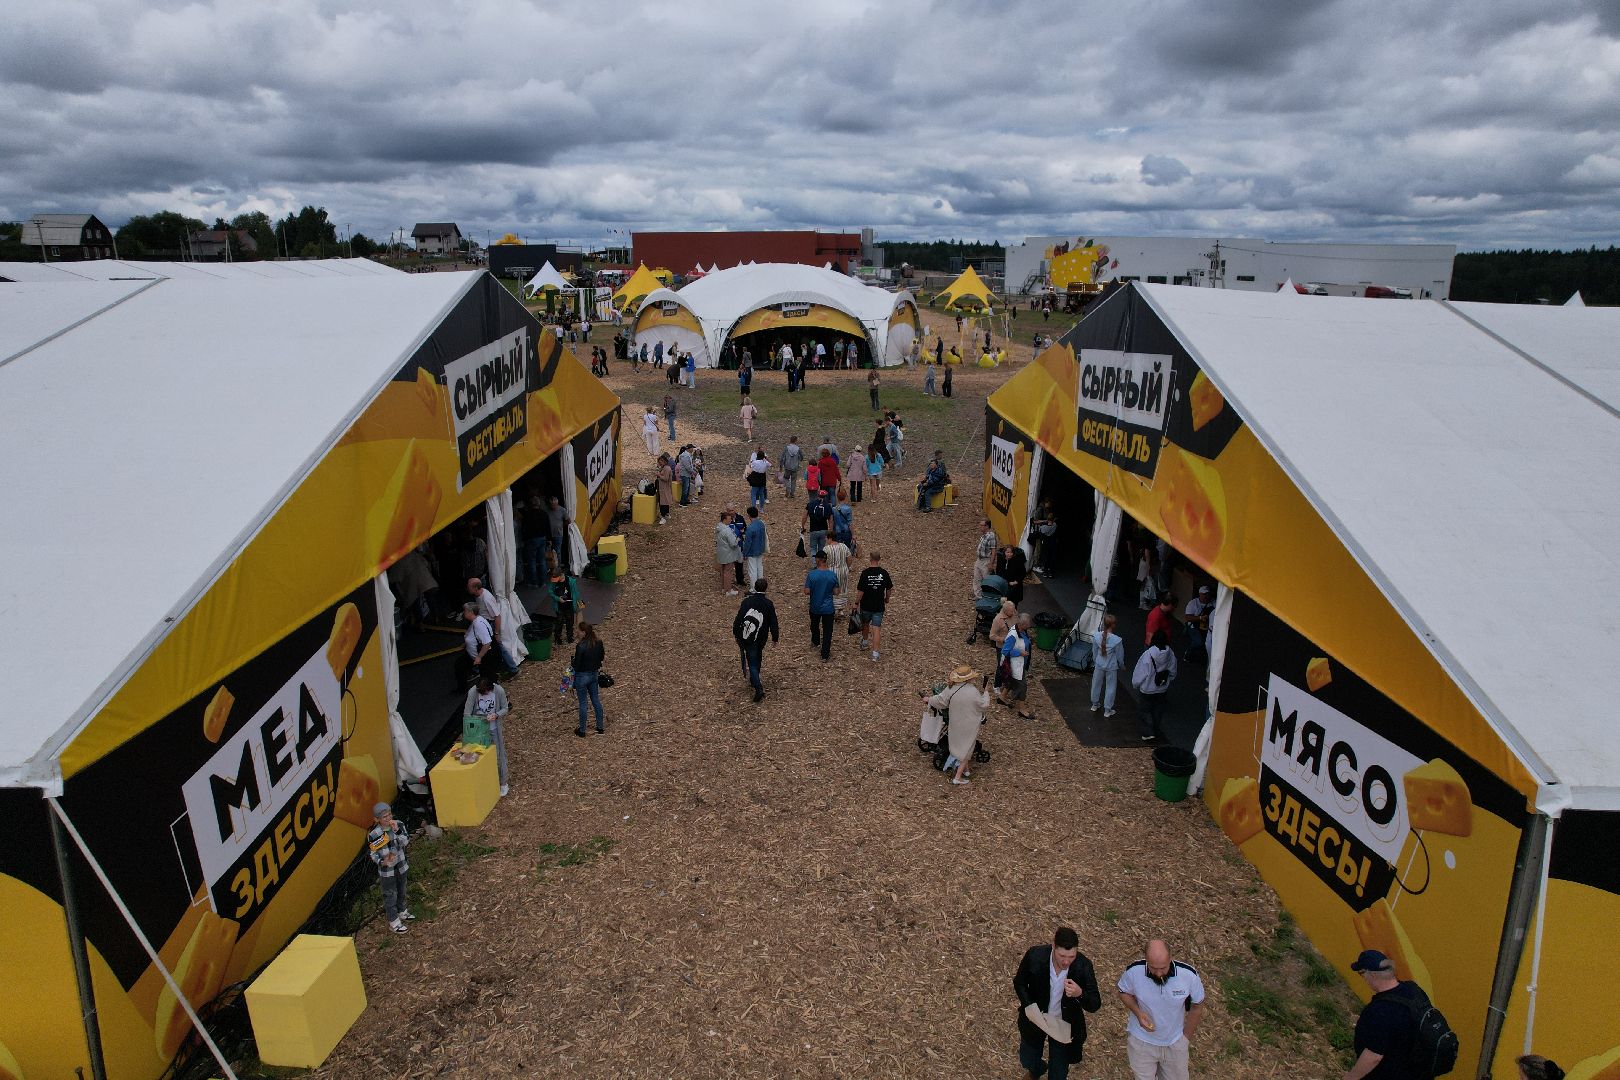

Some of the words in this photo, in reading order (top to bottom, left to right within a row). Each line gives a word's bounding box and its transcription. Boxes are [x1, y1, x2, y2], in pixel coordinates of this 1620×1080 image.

[454, 336, 524, 420] СЫРНЫЙ
[1081, 361, 1163, 414] СЫРНЫЙ
[589, 438, 609, 482] СЫР
[992, 443, 1014, 476] ПИВО
[209, 681, 328, 844] МЕД
[1269, 696, 1398, 825] МЯСО
[230, 762, 337, 919] ЗДЕСЬ!
[1264, 783, 1373, 898] ЗДЕСЬ!
